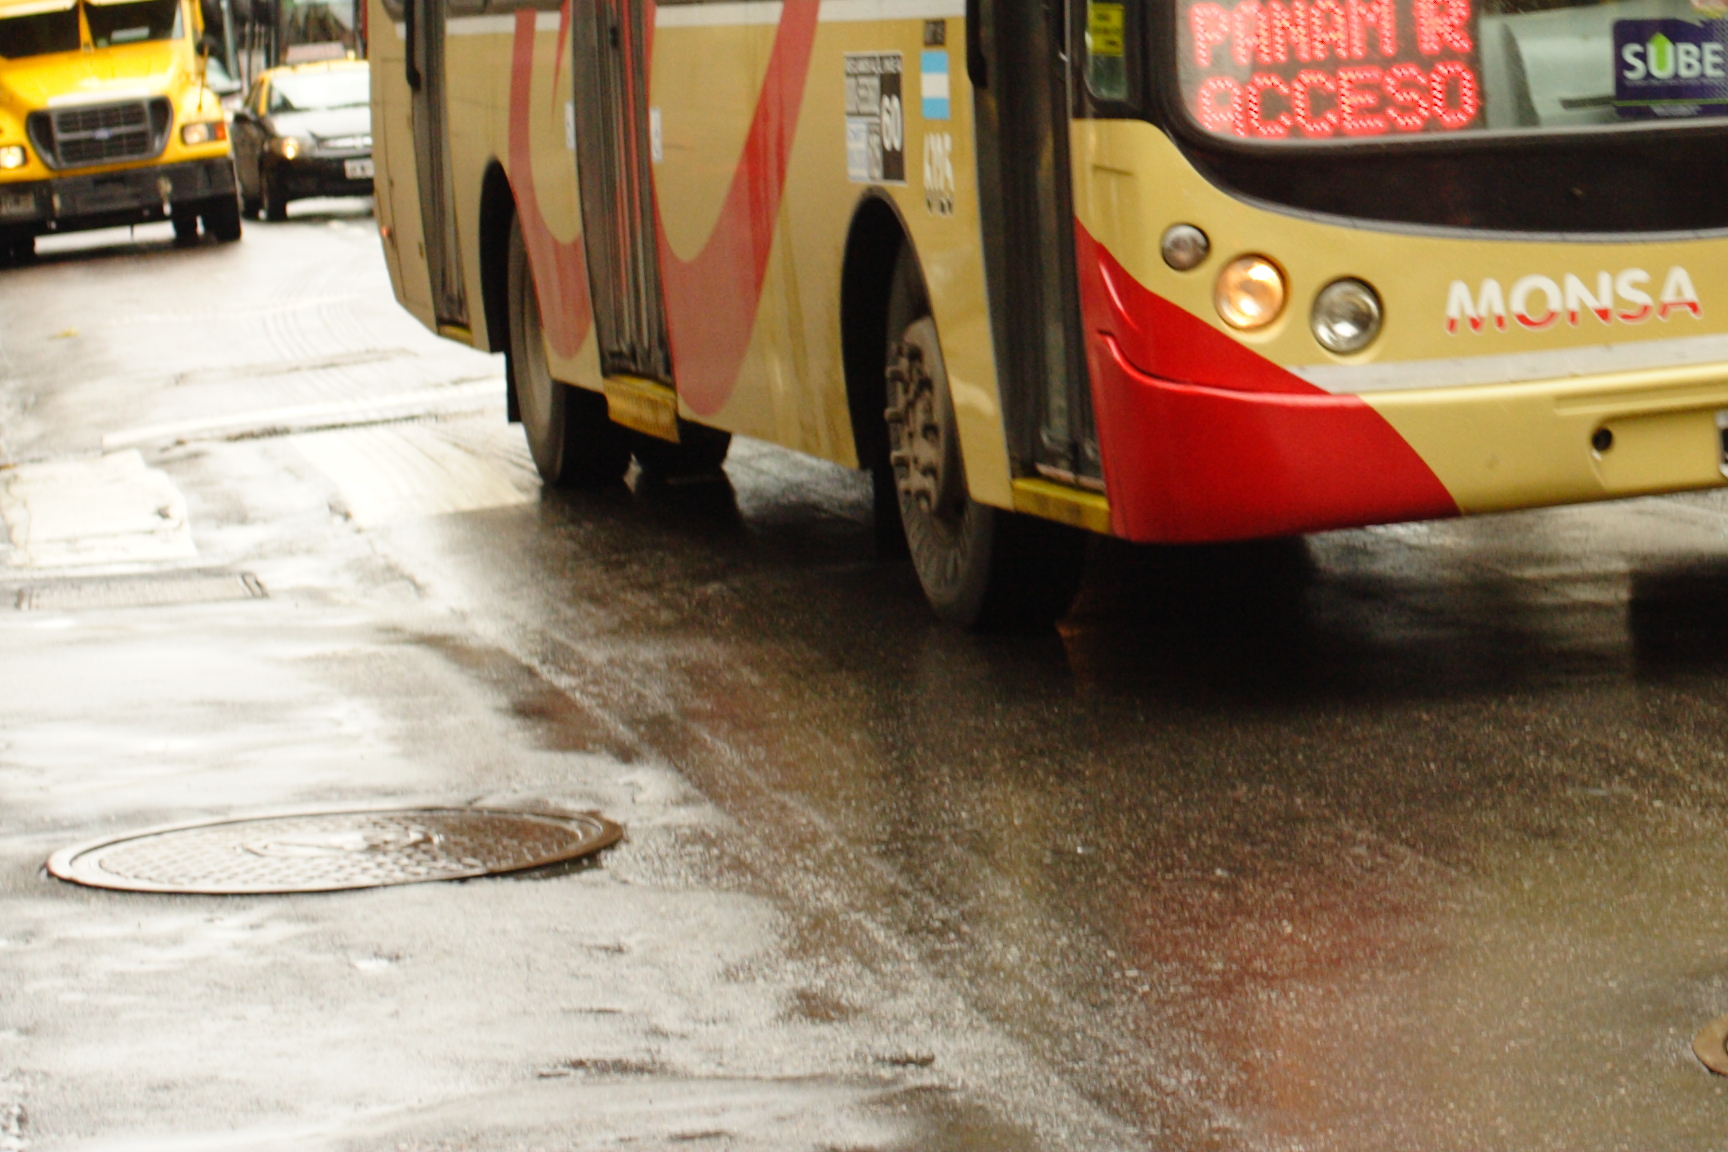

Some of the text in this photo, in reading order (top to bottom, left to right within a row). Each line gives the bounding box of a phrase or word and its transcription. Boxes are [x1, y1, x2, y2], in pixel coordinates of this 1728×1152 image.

[1621, 36, 1727, 81] SUBE
[880, 93, 904, 152] 60
[1198, 60, 1479, 137] ACCESO
[1445, 265, 1704, 336] MONSA
